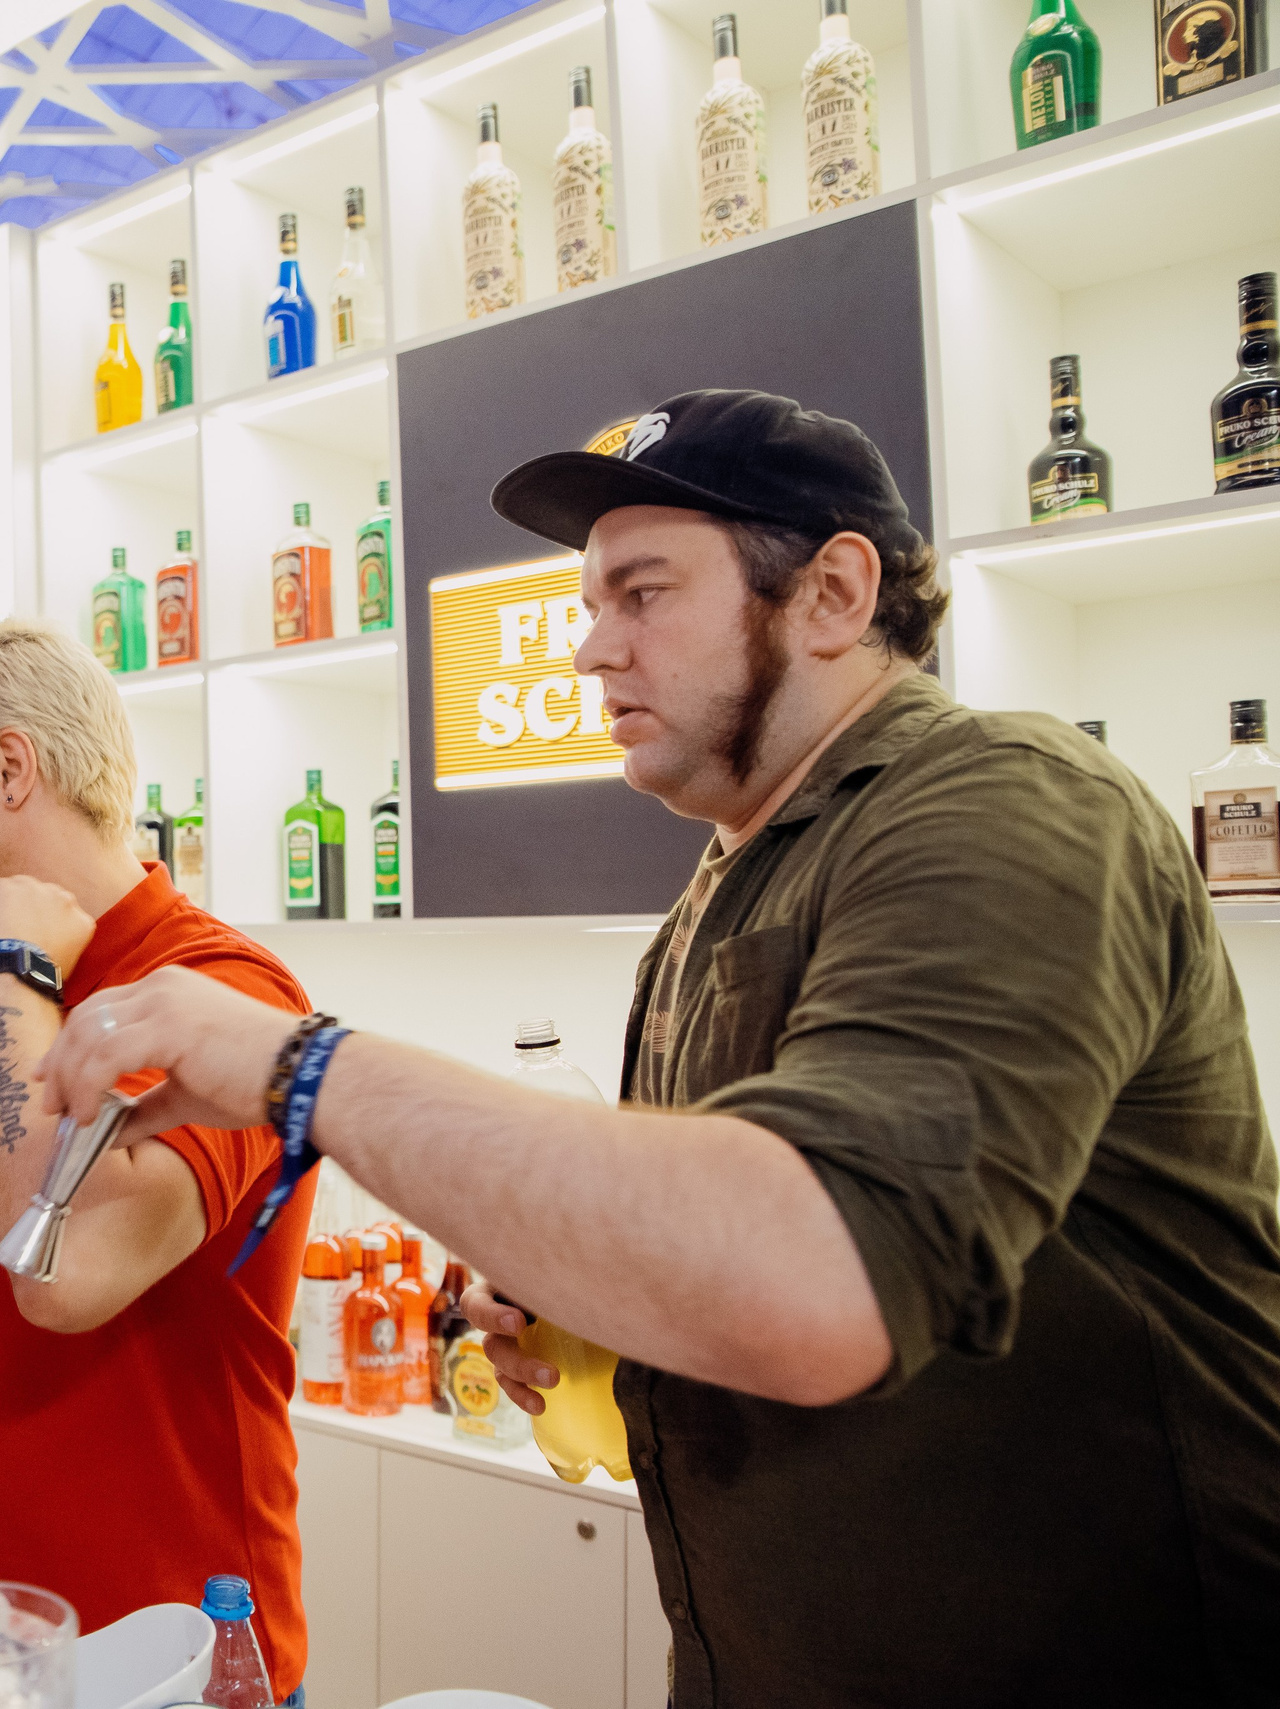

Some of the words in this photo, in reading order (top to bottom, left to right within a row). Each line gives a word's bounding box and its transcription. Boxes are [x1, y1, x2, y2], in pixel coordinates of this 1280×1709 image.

[806, 98, 855, 124] BARRISTER
[1029, 80, 1046, 129] MELON
[701, 137, 747, 161] BARRISTER
[1219, 420, 1252, 438] FRUKO
[1235, 425, 1280, 448] Cream
[595, 432, 625, 453] UKO
[1058, 479, 1096, 491] SCHULZ
[497, 595, 596, 668] FR
[1223, 810, 1257, 818] SCHULZ
[1226, 804, 1254, 812] FRUKO
[1216, 824, 1267, 837] COFETTO
